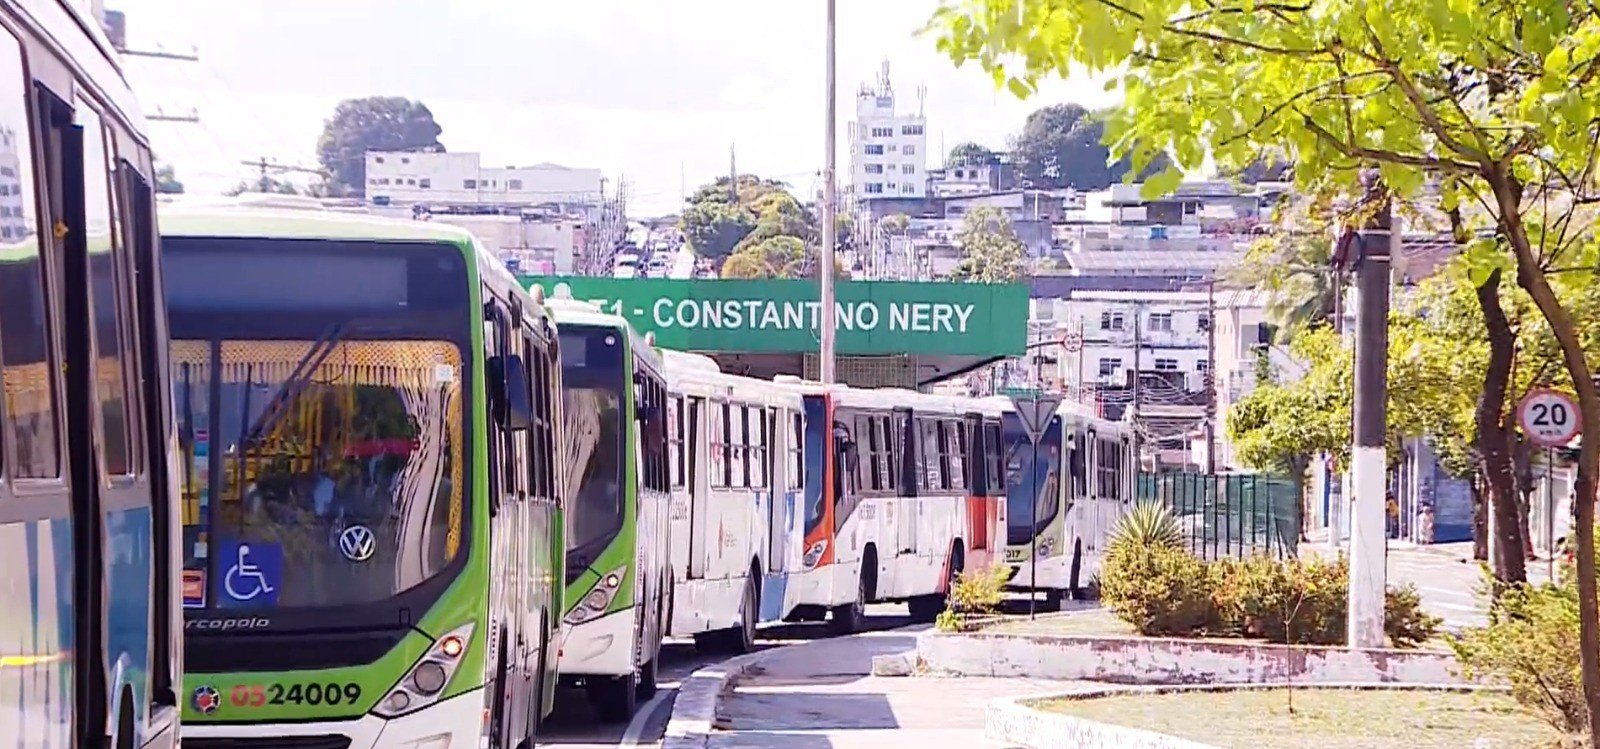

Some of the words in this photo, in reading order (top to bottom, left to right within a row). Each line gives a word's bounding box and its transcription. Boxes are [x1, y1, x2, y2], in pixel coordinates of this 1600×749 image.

[652, 297, 879, 331] CONSTANTNO
[889, 302, 975, 333] NERY
[1531, 403, 1567, 426] 20
